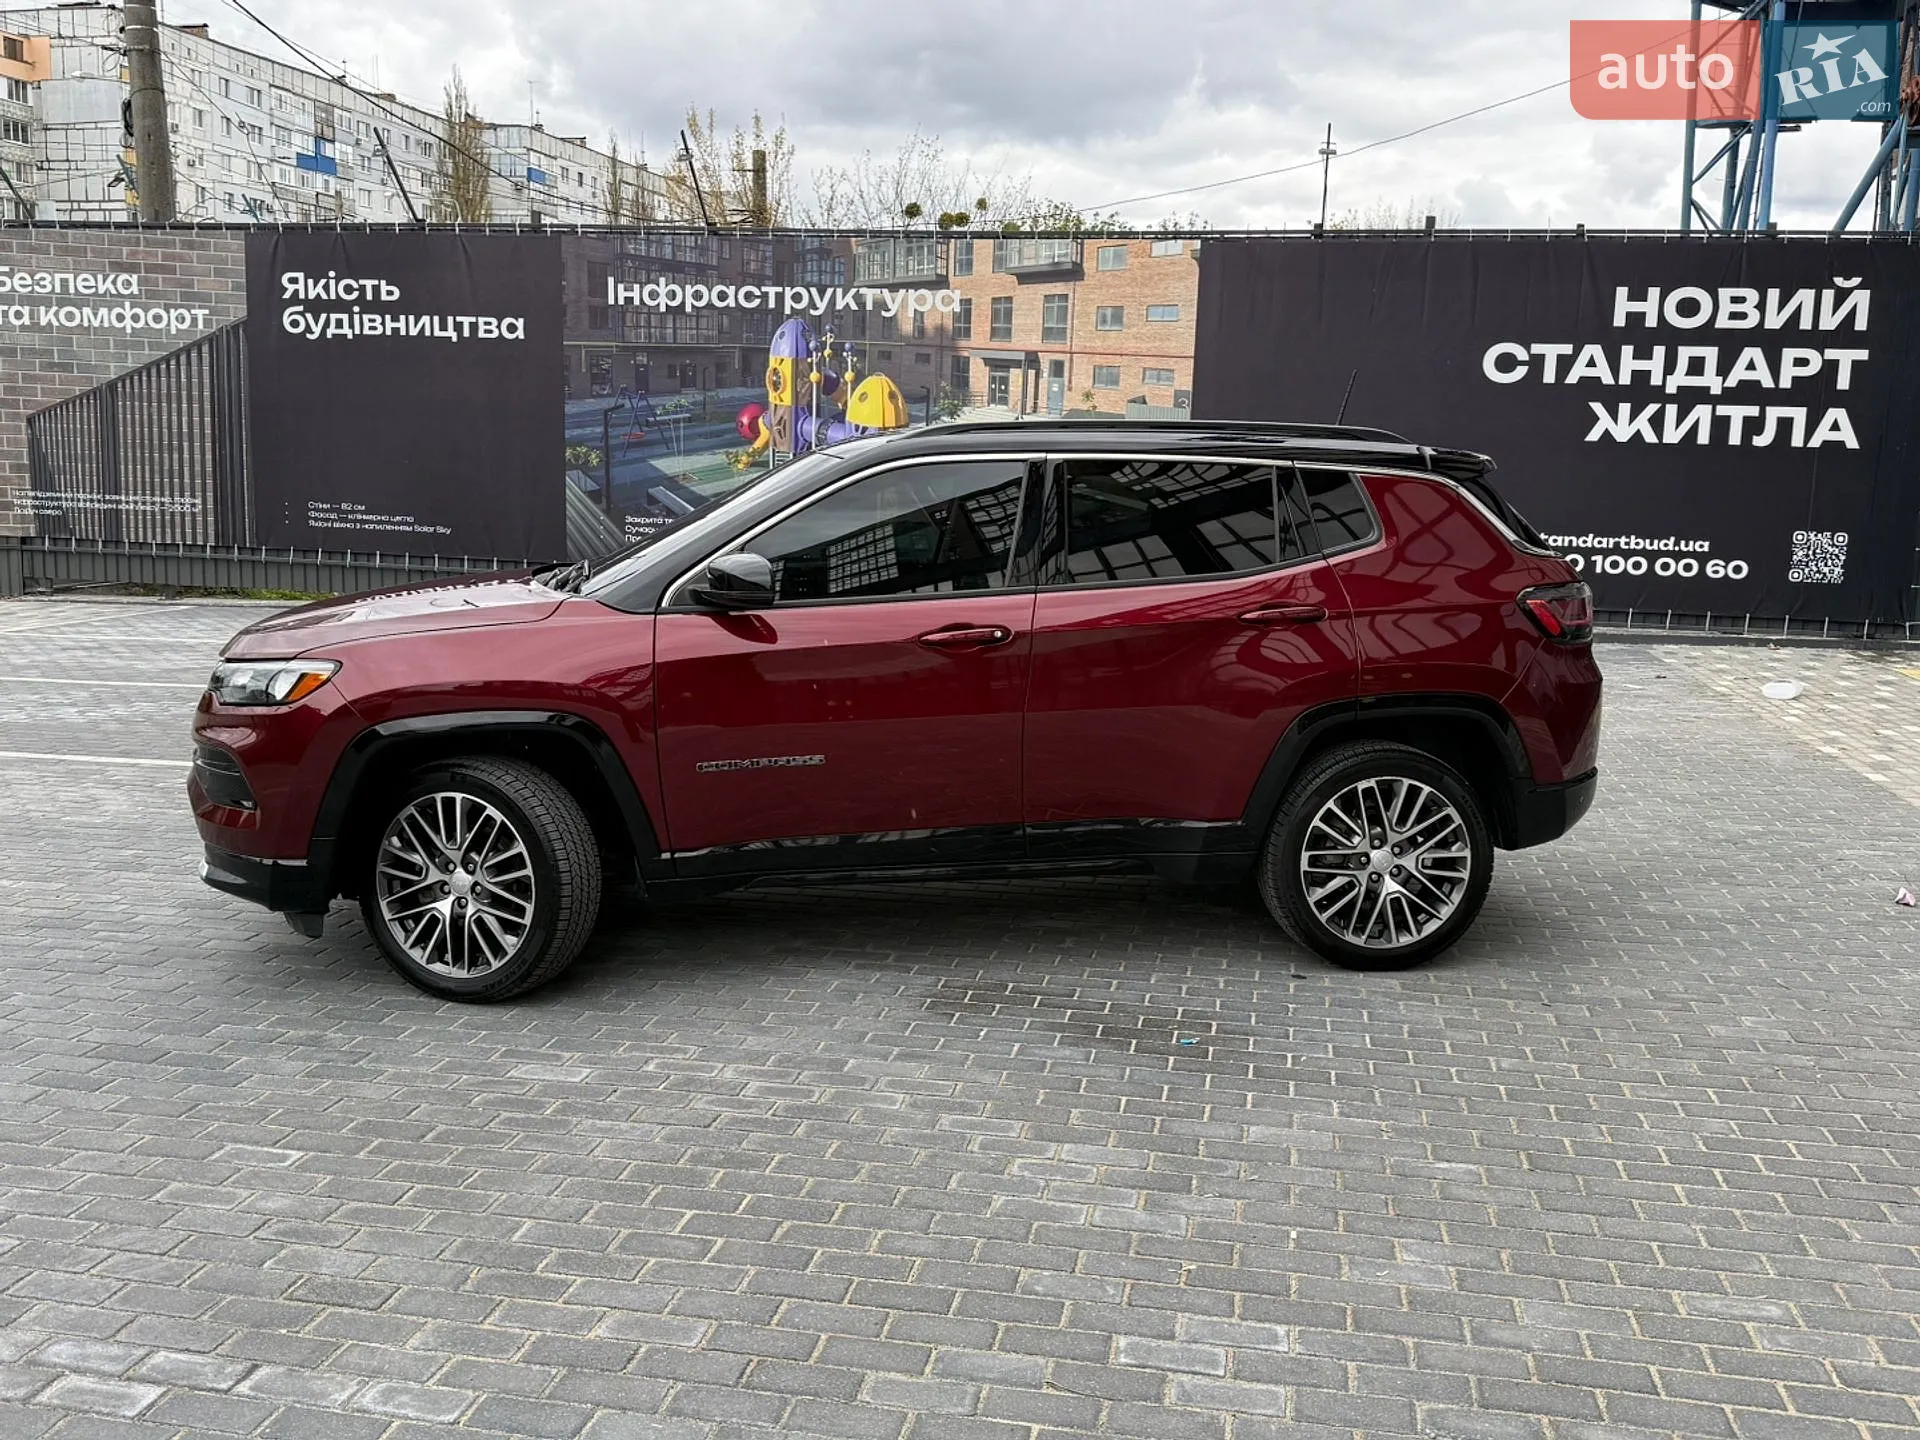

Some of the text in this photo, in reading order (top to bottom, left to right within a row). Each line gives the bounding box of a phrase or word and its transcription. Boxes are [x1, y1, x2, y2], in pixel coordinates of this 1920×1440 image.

[0, 266, 139, 295] Безпека
[281, 271, 400, 301] Якість
[607, 276, 961, 317] Інфраструктура
[39, 301, 209, 334] комфорт
[1613, 277, 1870, 331] НОВИЙ
[282, 306, 525, 342] будівництва
[1482, 342, 1869, 395] СТАНДАРТ
[1584, 402, 1859, 449] ЖИТЛА
[625, 515, 663, 525] Закрита
[1540, 533, 1710, 552] tandartbud.ua
[1591, 555, 1648, 576] 100
[1654, 557, 1699, 578] 00
[1705, 559, 1749, 580] 60
